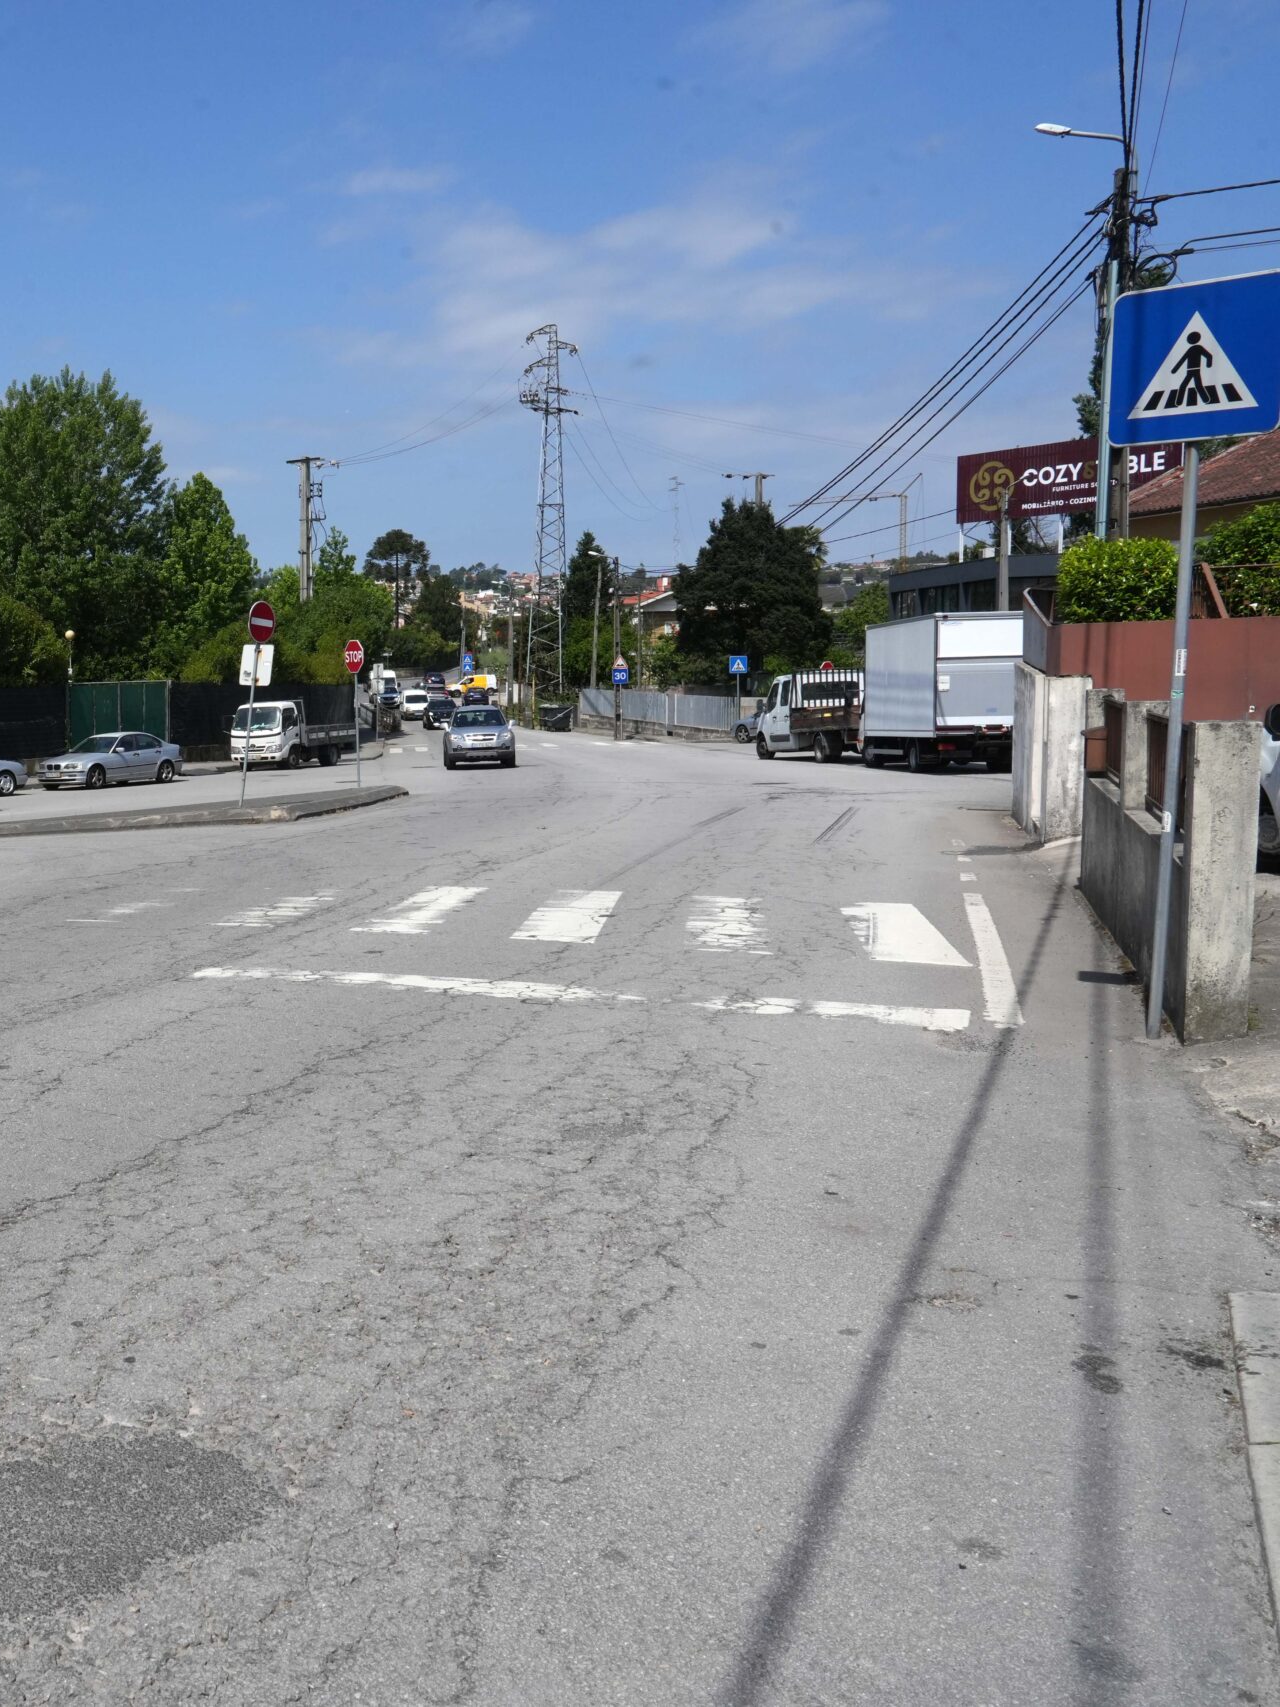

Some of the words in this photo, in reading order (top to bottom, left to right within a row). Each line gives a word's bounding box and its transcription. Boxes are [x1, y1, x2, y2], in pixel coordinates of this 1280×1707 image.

[1022, 462, 1083, 487] COZY
[1052, 482, 1089, 493] FURNITURE
[1069, 496, 1097, 505] COZINH
[345, 651, 362, 663] STOP
[614, 672, 626, 680] 30
